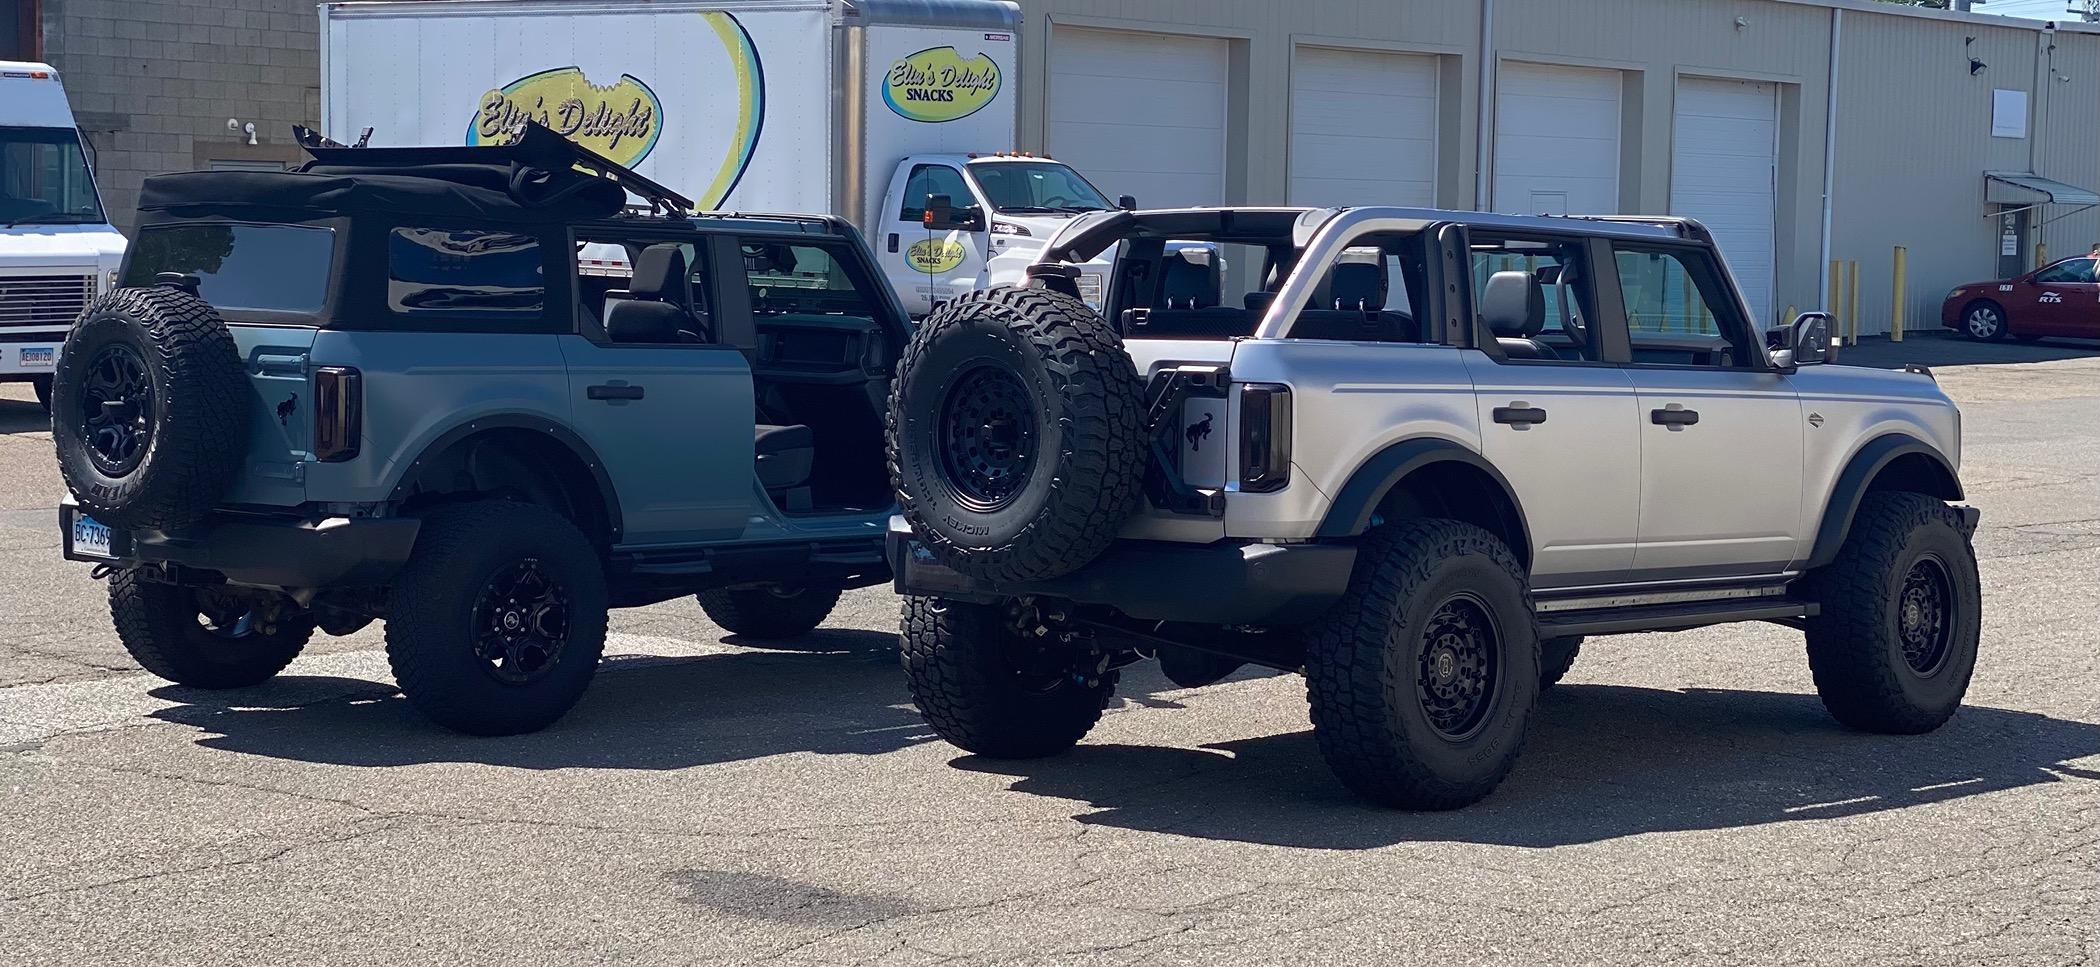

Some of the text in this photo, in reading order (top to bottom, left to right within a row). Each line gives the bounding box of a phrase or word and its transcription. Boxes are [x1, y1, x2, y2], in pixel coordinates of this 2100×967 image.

[941, 64, 995, 96] Delight
[906, 88, 954, 102] SNACKS
[558, 97, 652, 150] Delight
[916, 256, 942, 265] SNACKS
[942, 514, 990, 536] MICKEY
